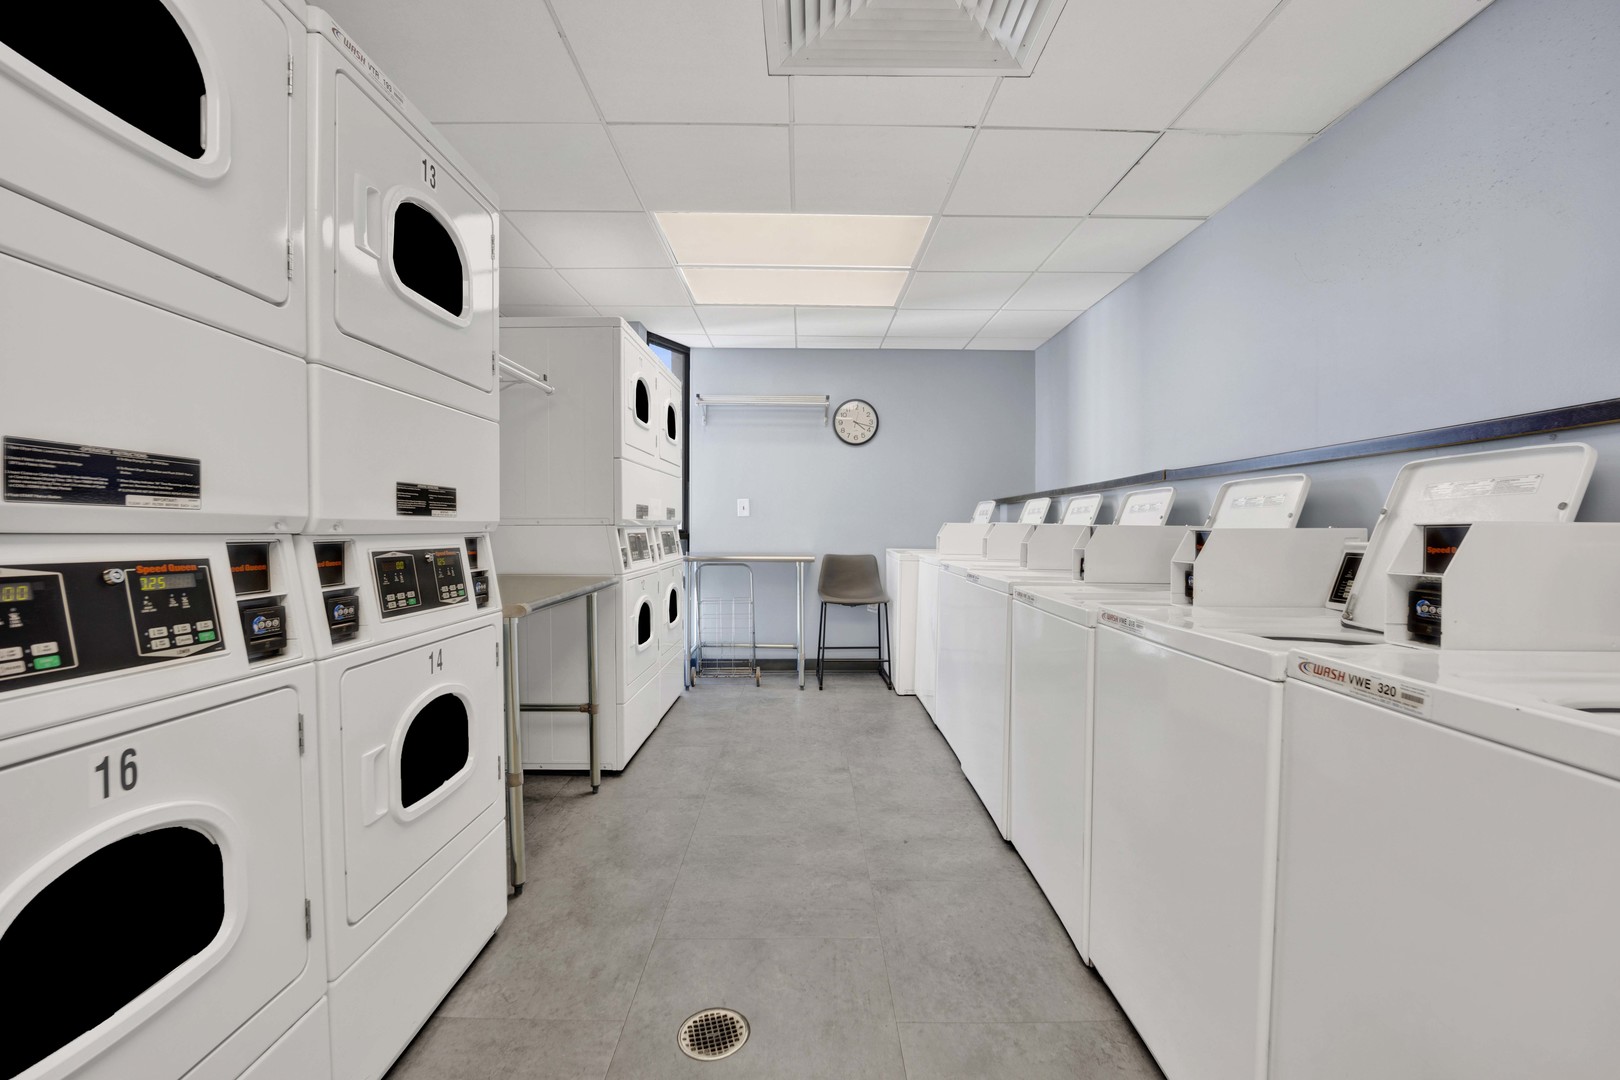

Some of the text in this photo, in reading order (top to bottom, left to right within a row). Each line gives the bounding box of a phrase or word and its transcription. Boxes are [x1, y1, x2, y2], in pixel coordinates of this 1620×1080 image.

[343, 37, 366, 65] WASH
[422, 159, 436, 189] 13
[1427, 546, 1450, 554] Speed
[136, 564, 198, 575] Speed Queen
[229, 564, 268, 573] eed Queen
[2, 585, 28, 602] 00
[140, 576, 166, 591] 125
[428, 648, 443, 674] 14
[1312, 664, 1397, 698] WASH VWE 320
[94, 748, 138, 799] 16
